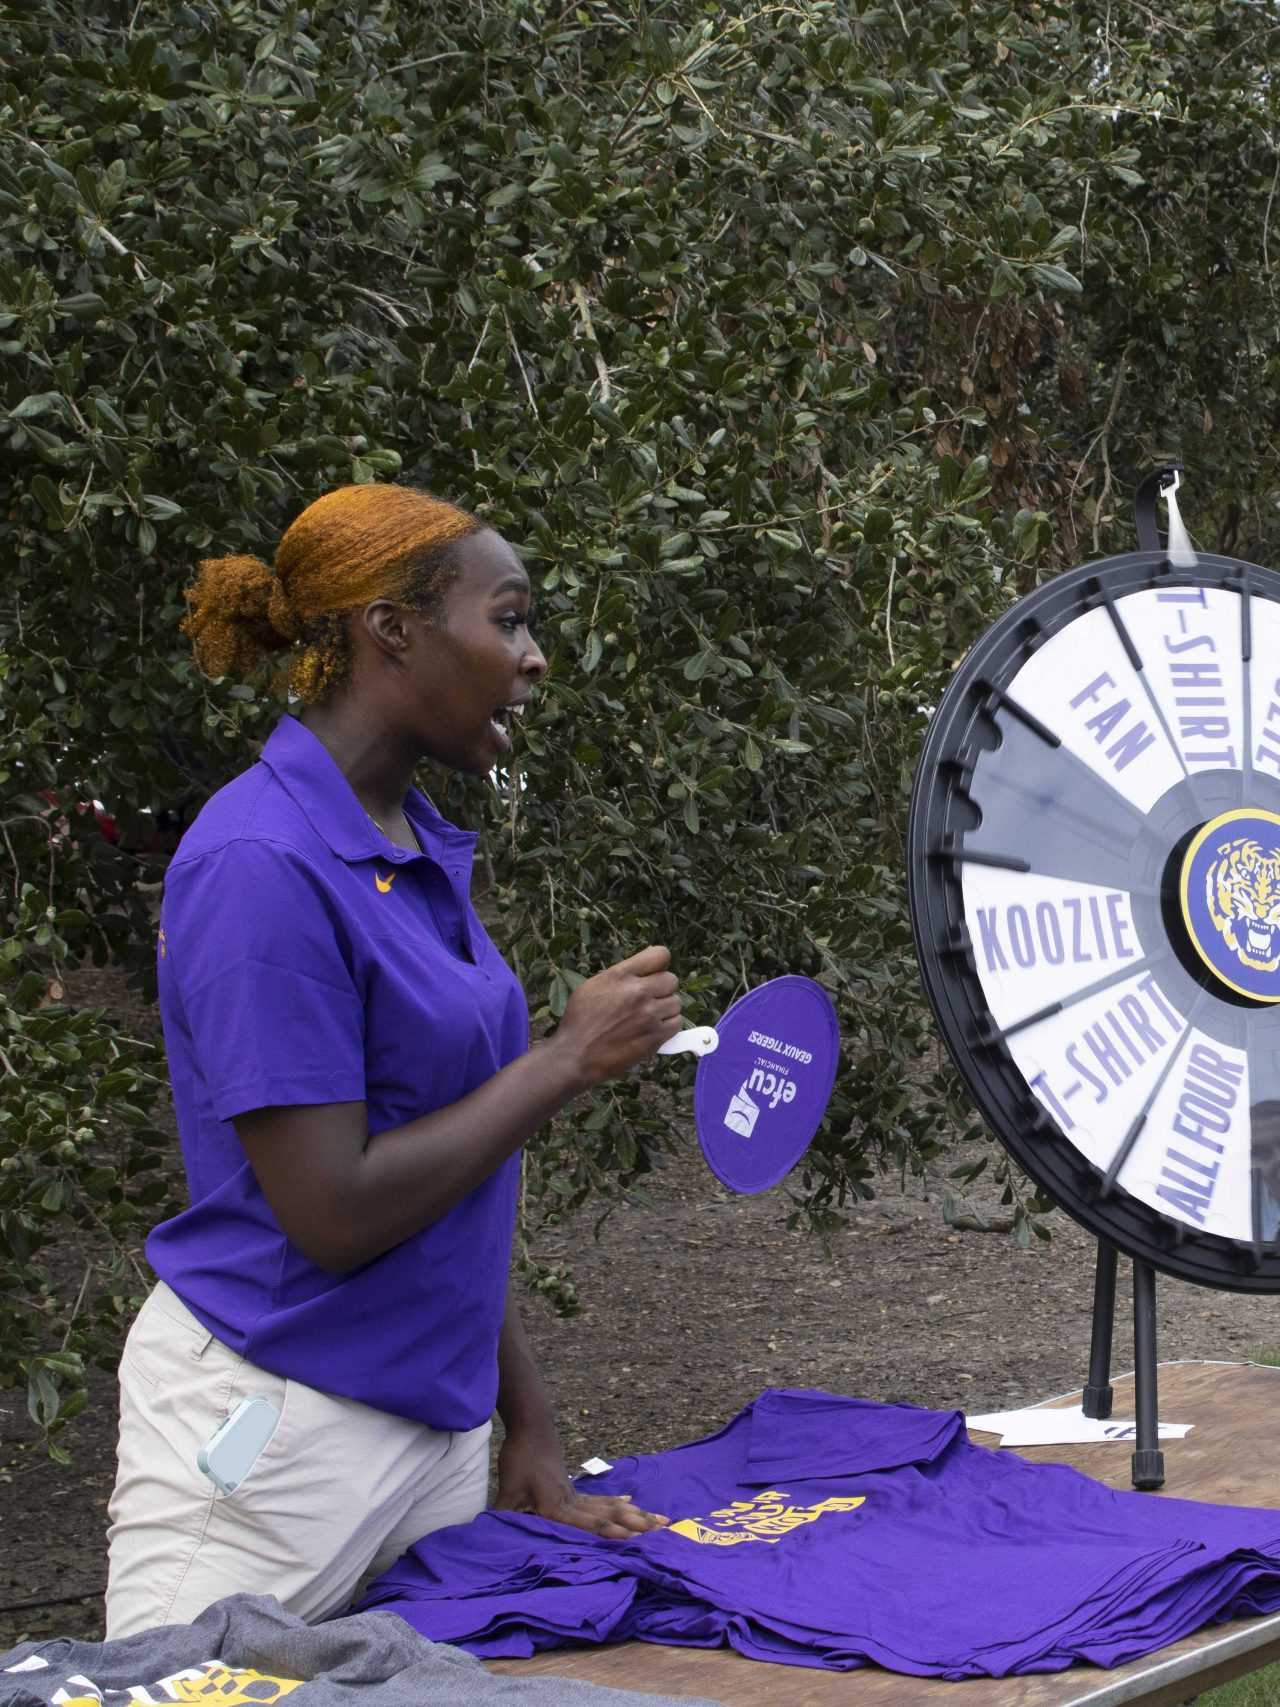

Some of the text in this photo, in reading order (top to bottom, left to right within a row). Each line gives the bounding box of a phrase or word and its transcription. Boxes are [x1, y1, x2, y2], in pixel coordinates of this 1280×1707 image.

[1069, 671, 1156, 772] FAN
[1156, 587, 1237, 768] T-SHIRT
[976, 893, 1134, 973] KOOZIE
[749, 1067, 796, 1109] efcu
[782, 1043, 812, 1065] GEAUX
[1030, 974, 1183, 1131] T-SHIRT
[1155, 1043, 1245, 1225] ALL FOUR
